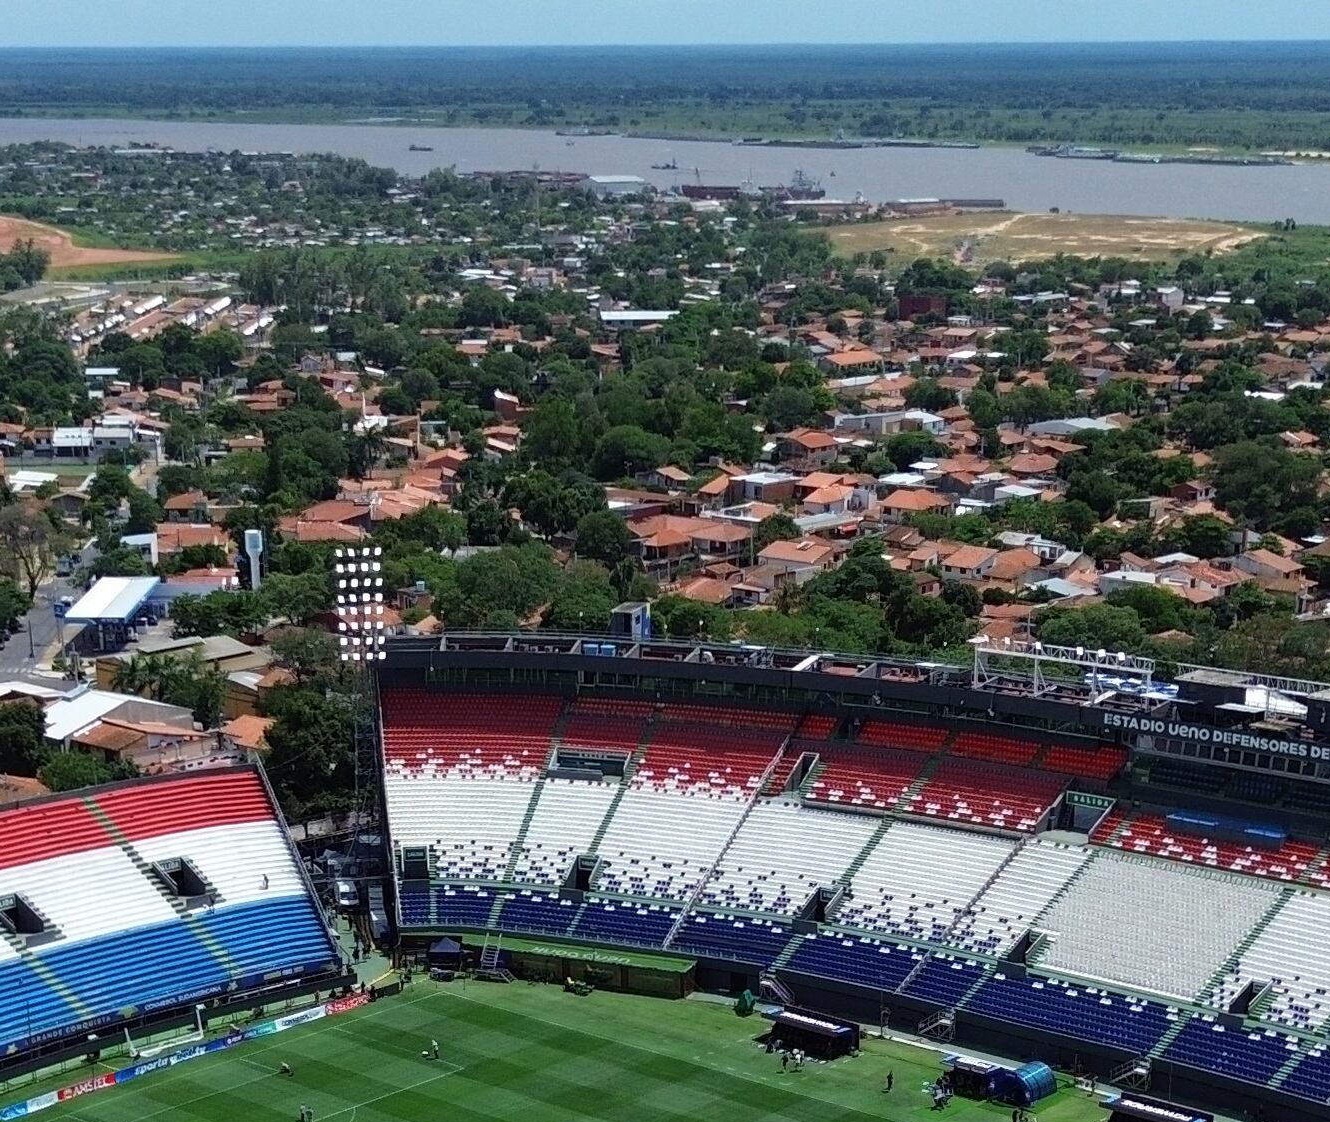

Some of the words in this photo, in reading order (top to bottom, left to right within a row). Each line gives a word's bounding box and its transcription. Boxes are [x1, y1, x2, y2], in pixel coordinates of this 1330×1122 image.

[1104, 712, 1165, 734] ESTADIO
[1212, 731, 1308, 758] DEFENSORES
[1073, 795, 1109, 807] SALIDA
[31, 1028, 63, 1044] GRANDE
[65, 1016, 111, 1034] CONQUISTA
[72, 1078, 109, 1097] AMSTEL
